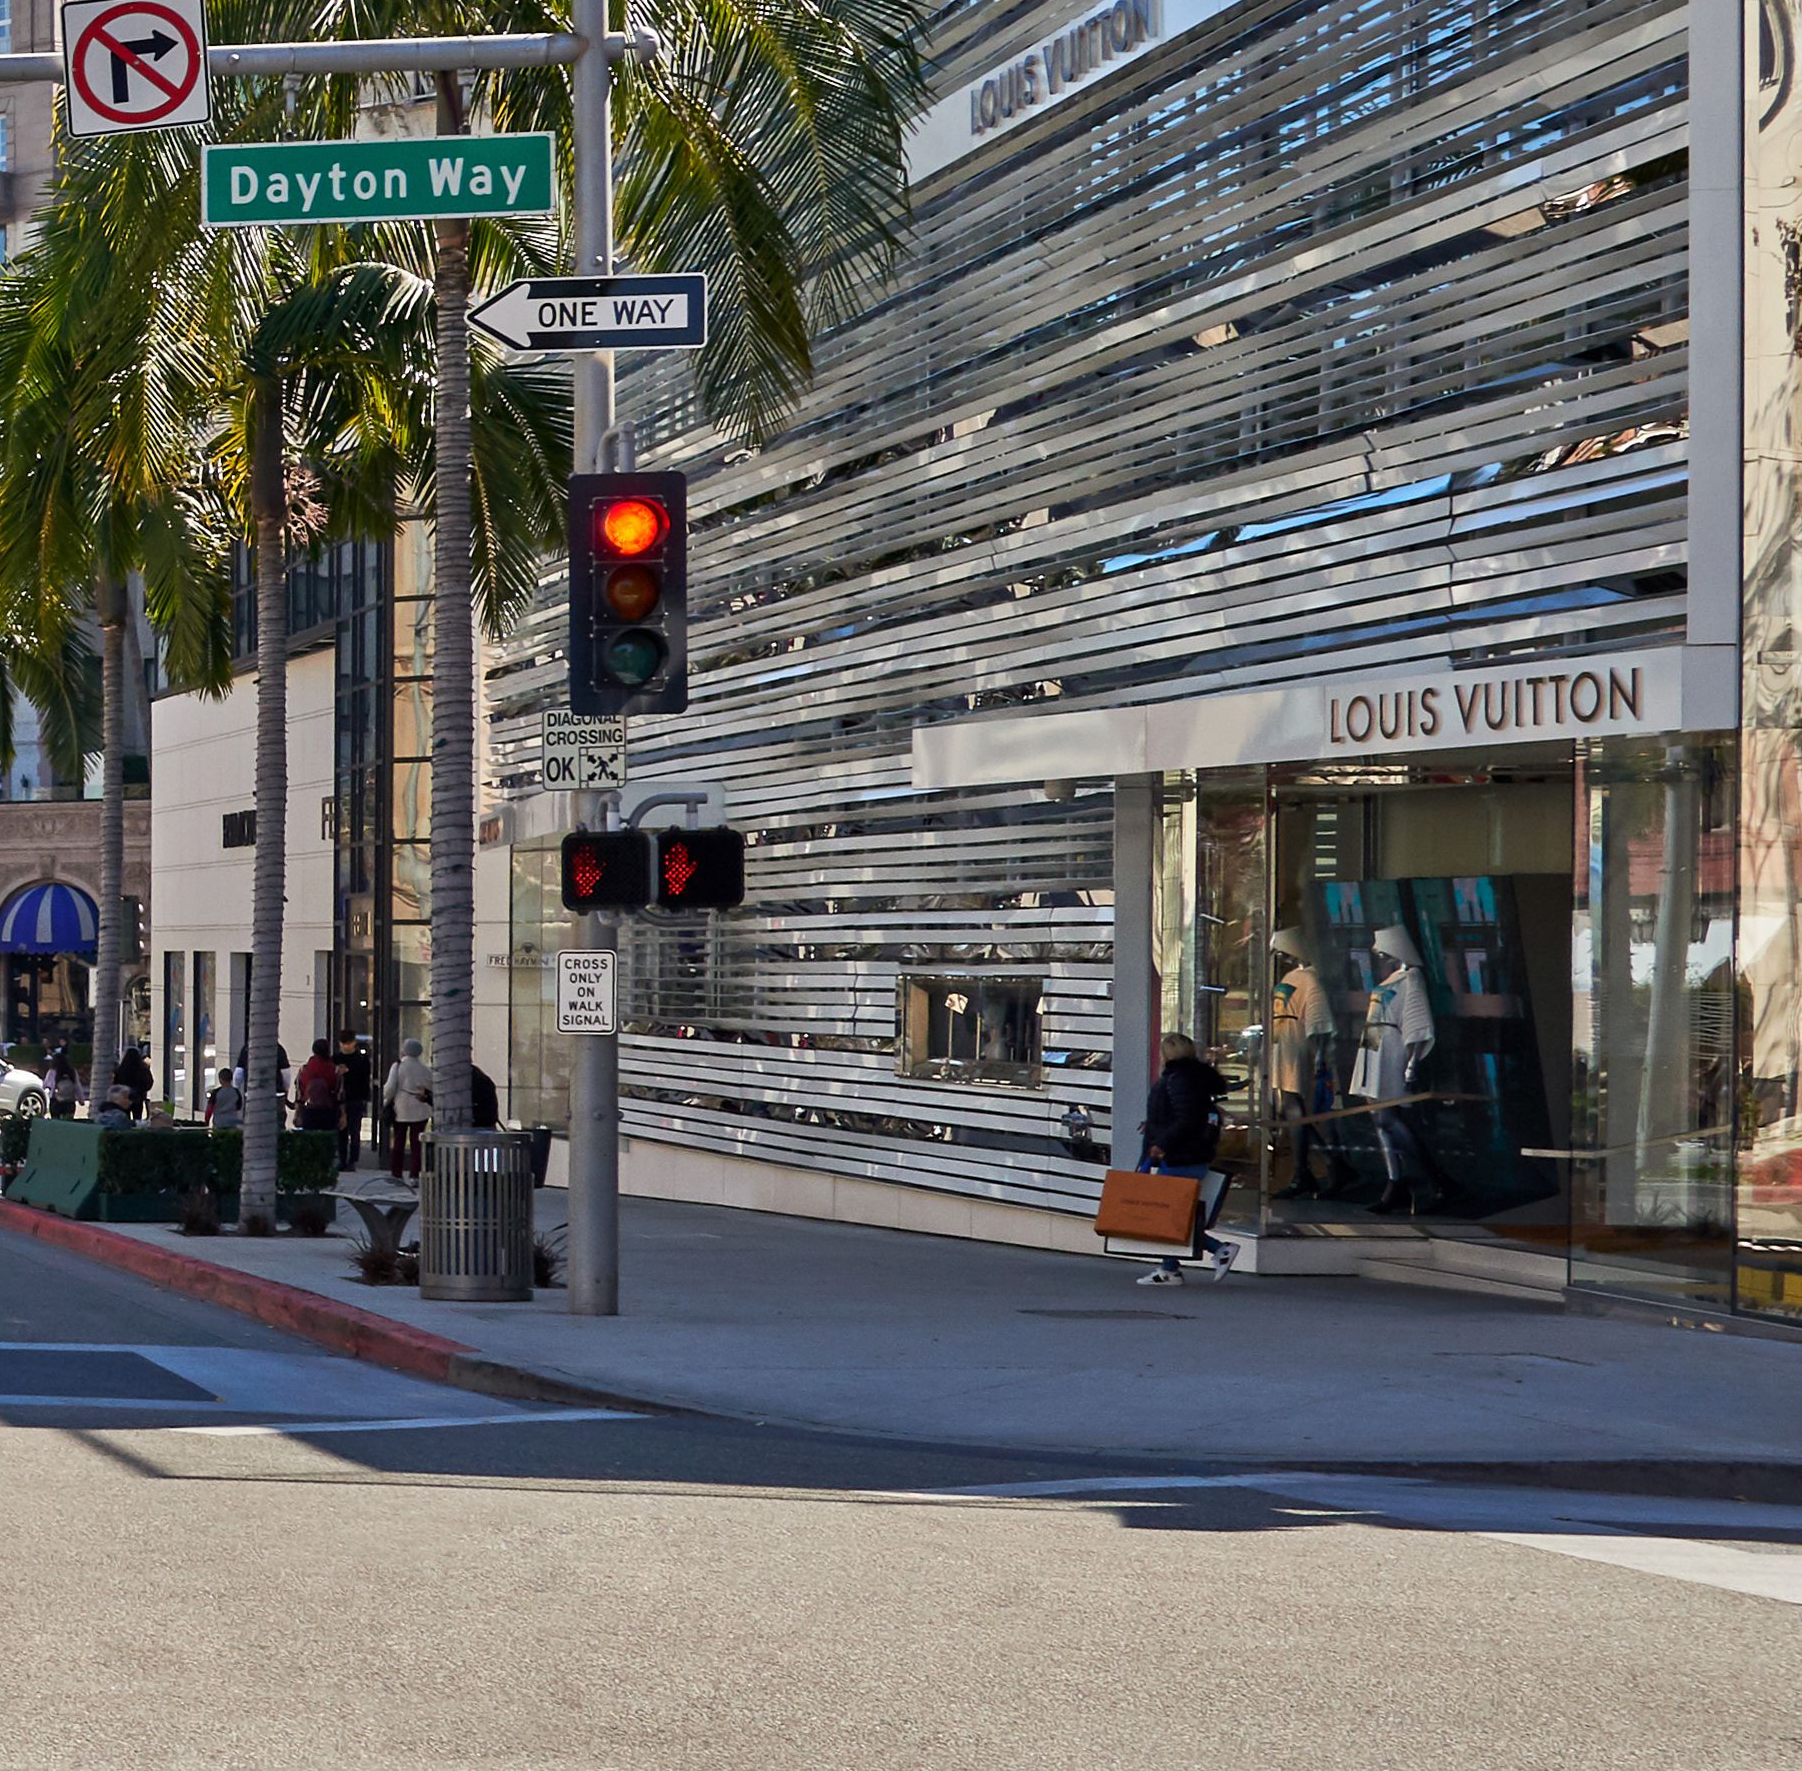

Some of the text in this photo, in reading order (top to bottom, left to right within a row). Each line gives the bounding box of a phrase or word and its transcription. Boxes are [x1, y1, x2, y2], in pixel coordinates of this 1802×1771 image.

[970, 55, 1045, 135] LOUIS
[230, 157, 527, 213] Dayton Way
[538, 298, 675, 328] ONE WAY
[1331, 666, 1644, 744] LOUIS VUITTON
[546, 728, 623, 746] CROSSING
[546, 757, 575, 782] OK
[565, 958, 608, 970] CROSS
[570, 973, 602, 984] ONLY
[577, 987, 595, 998] ON
[568, 1001, 603, 1012] WALK
[562, 1014, 609, 1026] SIGNAL
